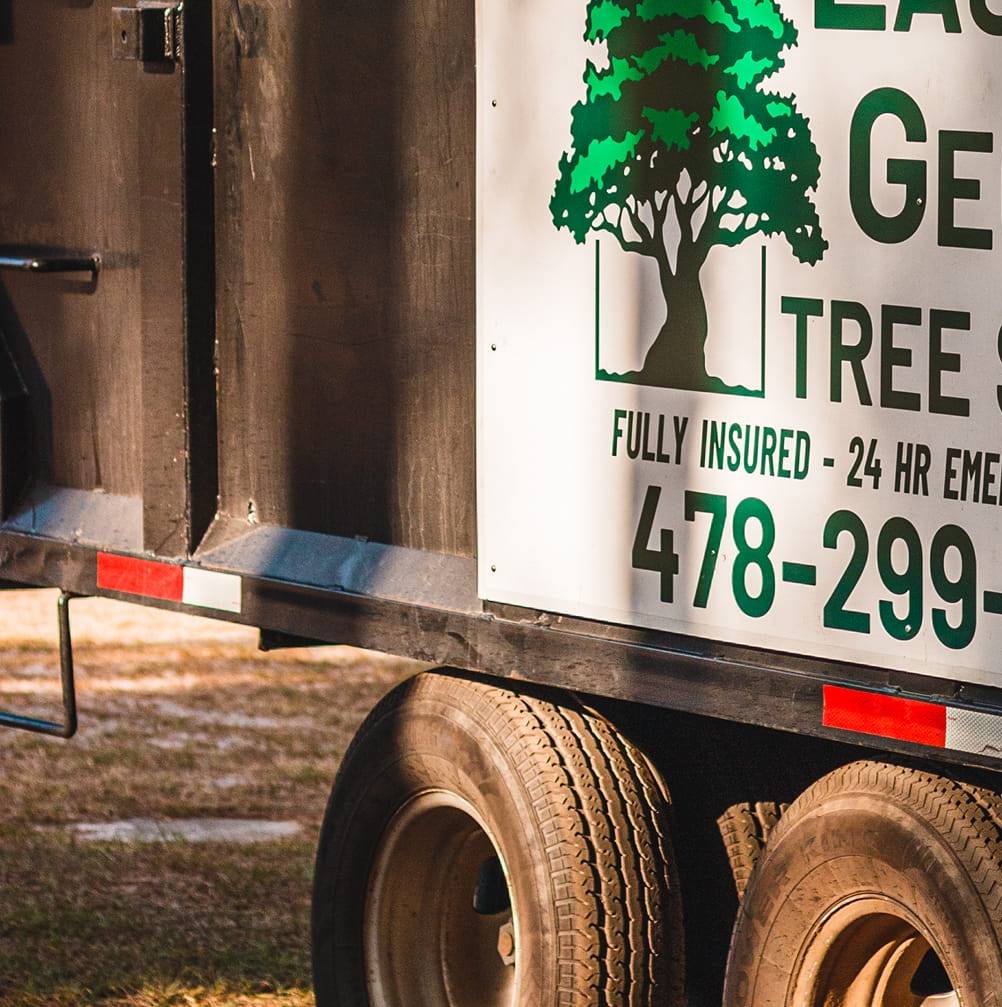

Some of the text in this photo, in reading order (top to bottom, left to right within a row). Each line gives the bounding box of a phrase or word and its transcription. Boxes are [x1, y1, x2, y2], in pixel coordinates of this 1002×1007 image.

[781, 295, 971, 418] TREE
[612, 409, 688, 466] FULLY
[700, 419, 811, 480] INSURED
[846, 436, 882, 488] 24
[894, 441, 932, 497] HR
